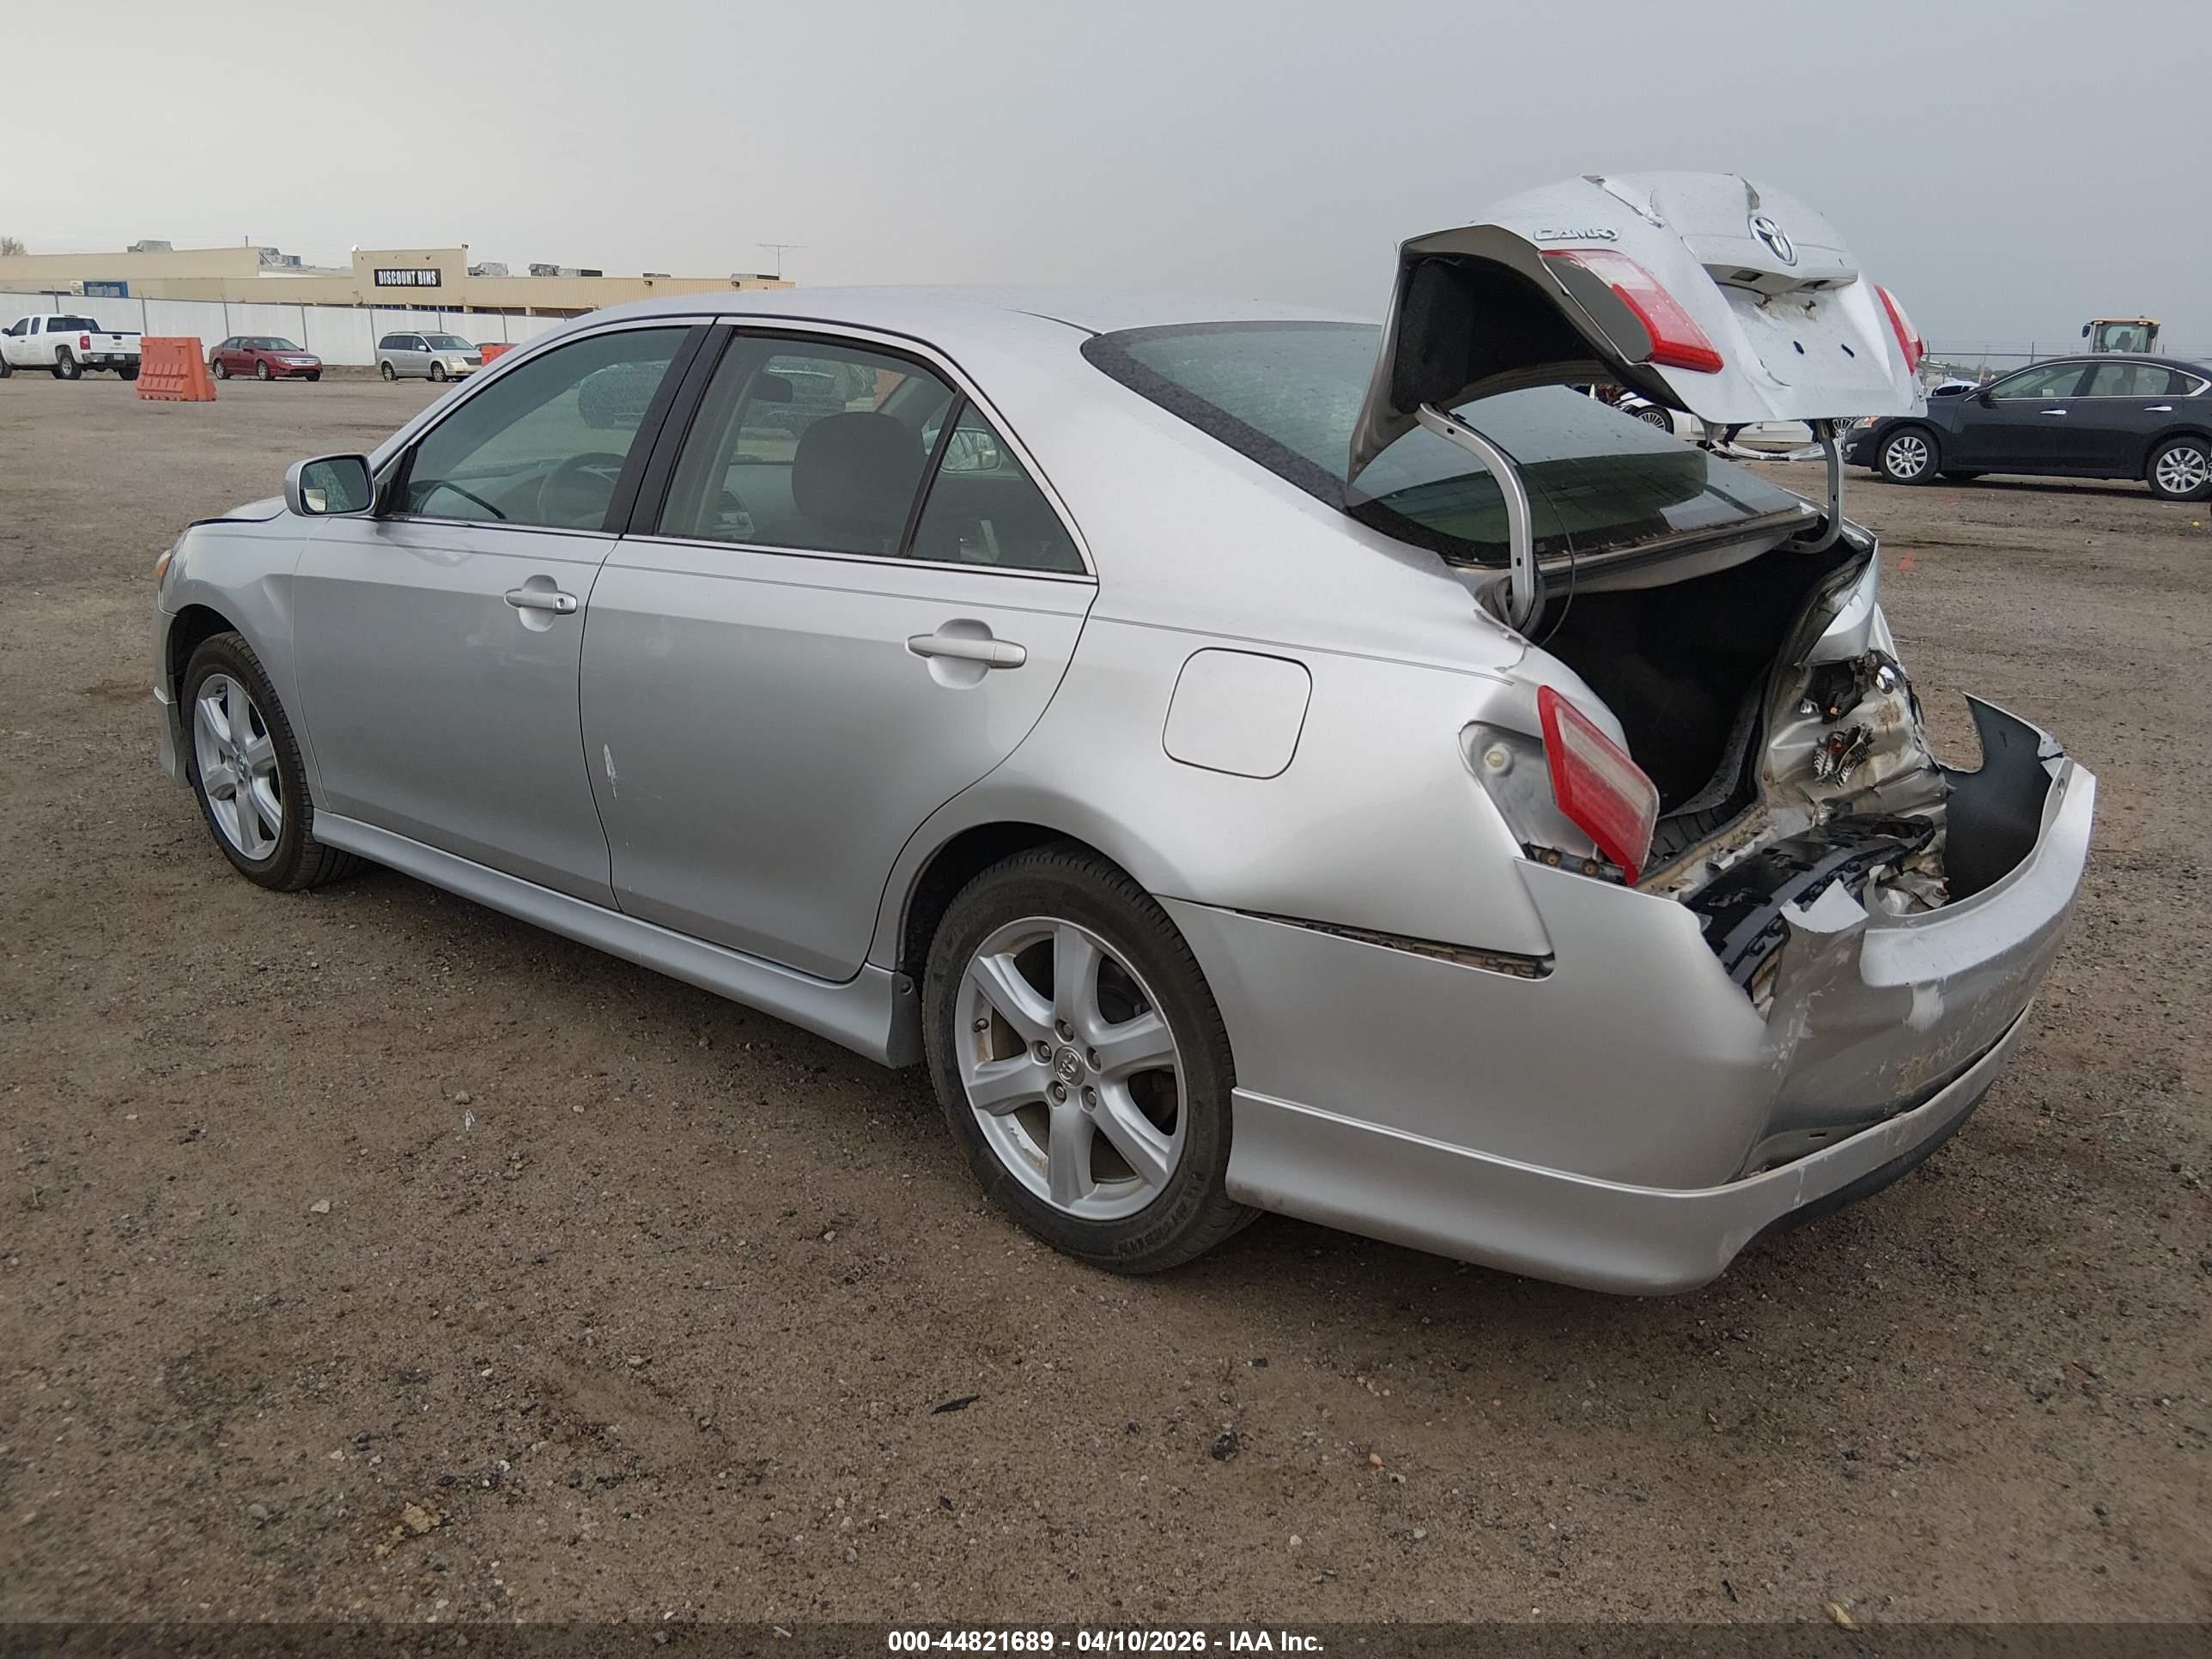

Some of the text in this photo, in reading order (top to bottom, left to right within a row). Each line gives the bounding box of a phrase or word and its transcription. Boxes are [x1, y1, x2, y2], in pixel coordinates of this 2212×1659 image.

[1534, 227, 1622, 242] CAMRY
[379, 270, 437, 285] DISCOUNT BINS
